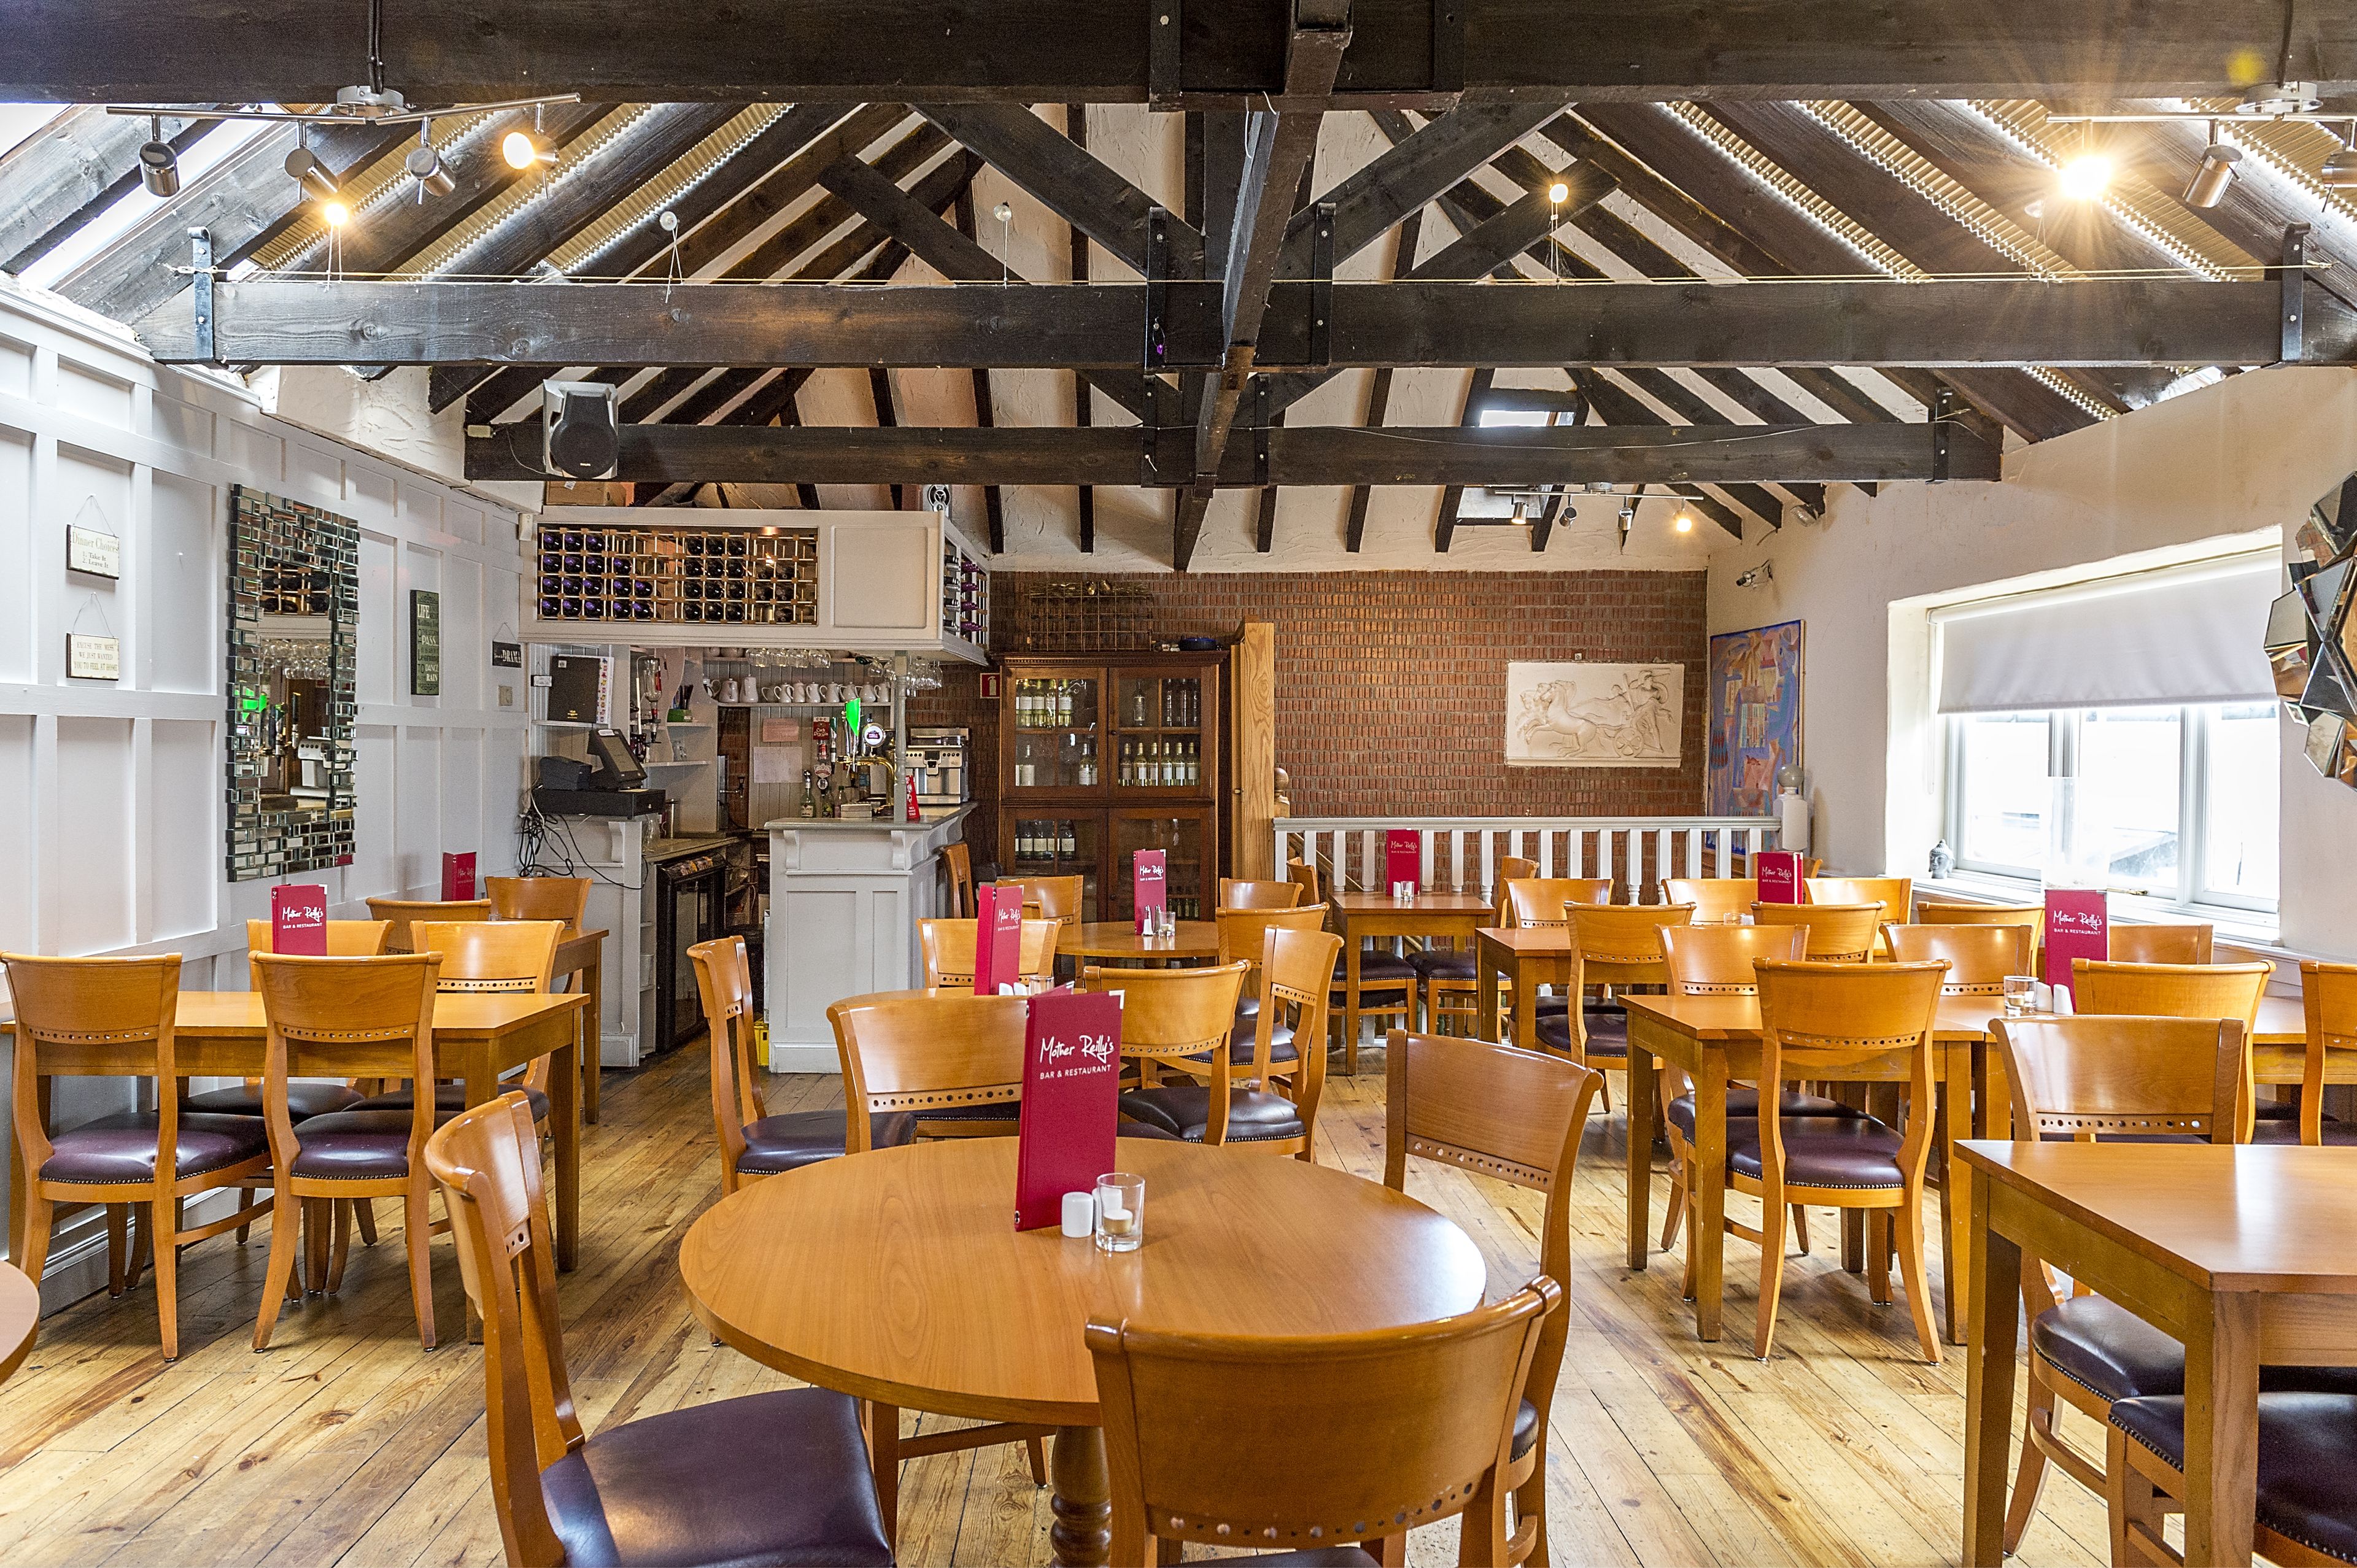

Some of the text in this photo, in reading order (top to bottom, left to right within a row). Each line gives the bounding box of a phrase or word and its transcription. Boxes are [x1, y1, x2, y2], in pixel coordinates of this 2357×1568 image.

[72, 531, 118, 553] Dinner Choices
[88, 559, 103, 568] Leave
[417, 604, 430, 619] LIFE
[282, 906, 302, 921] Mother
[2053, 910, 2102, 930] Mother Reilly's
[1040, 1035, 1115, 1065] Mother Reilly's
[1040, 1071, 1055, 1080] BAR
[1064, 1064, 1112, 1077] RESTAURANT
